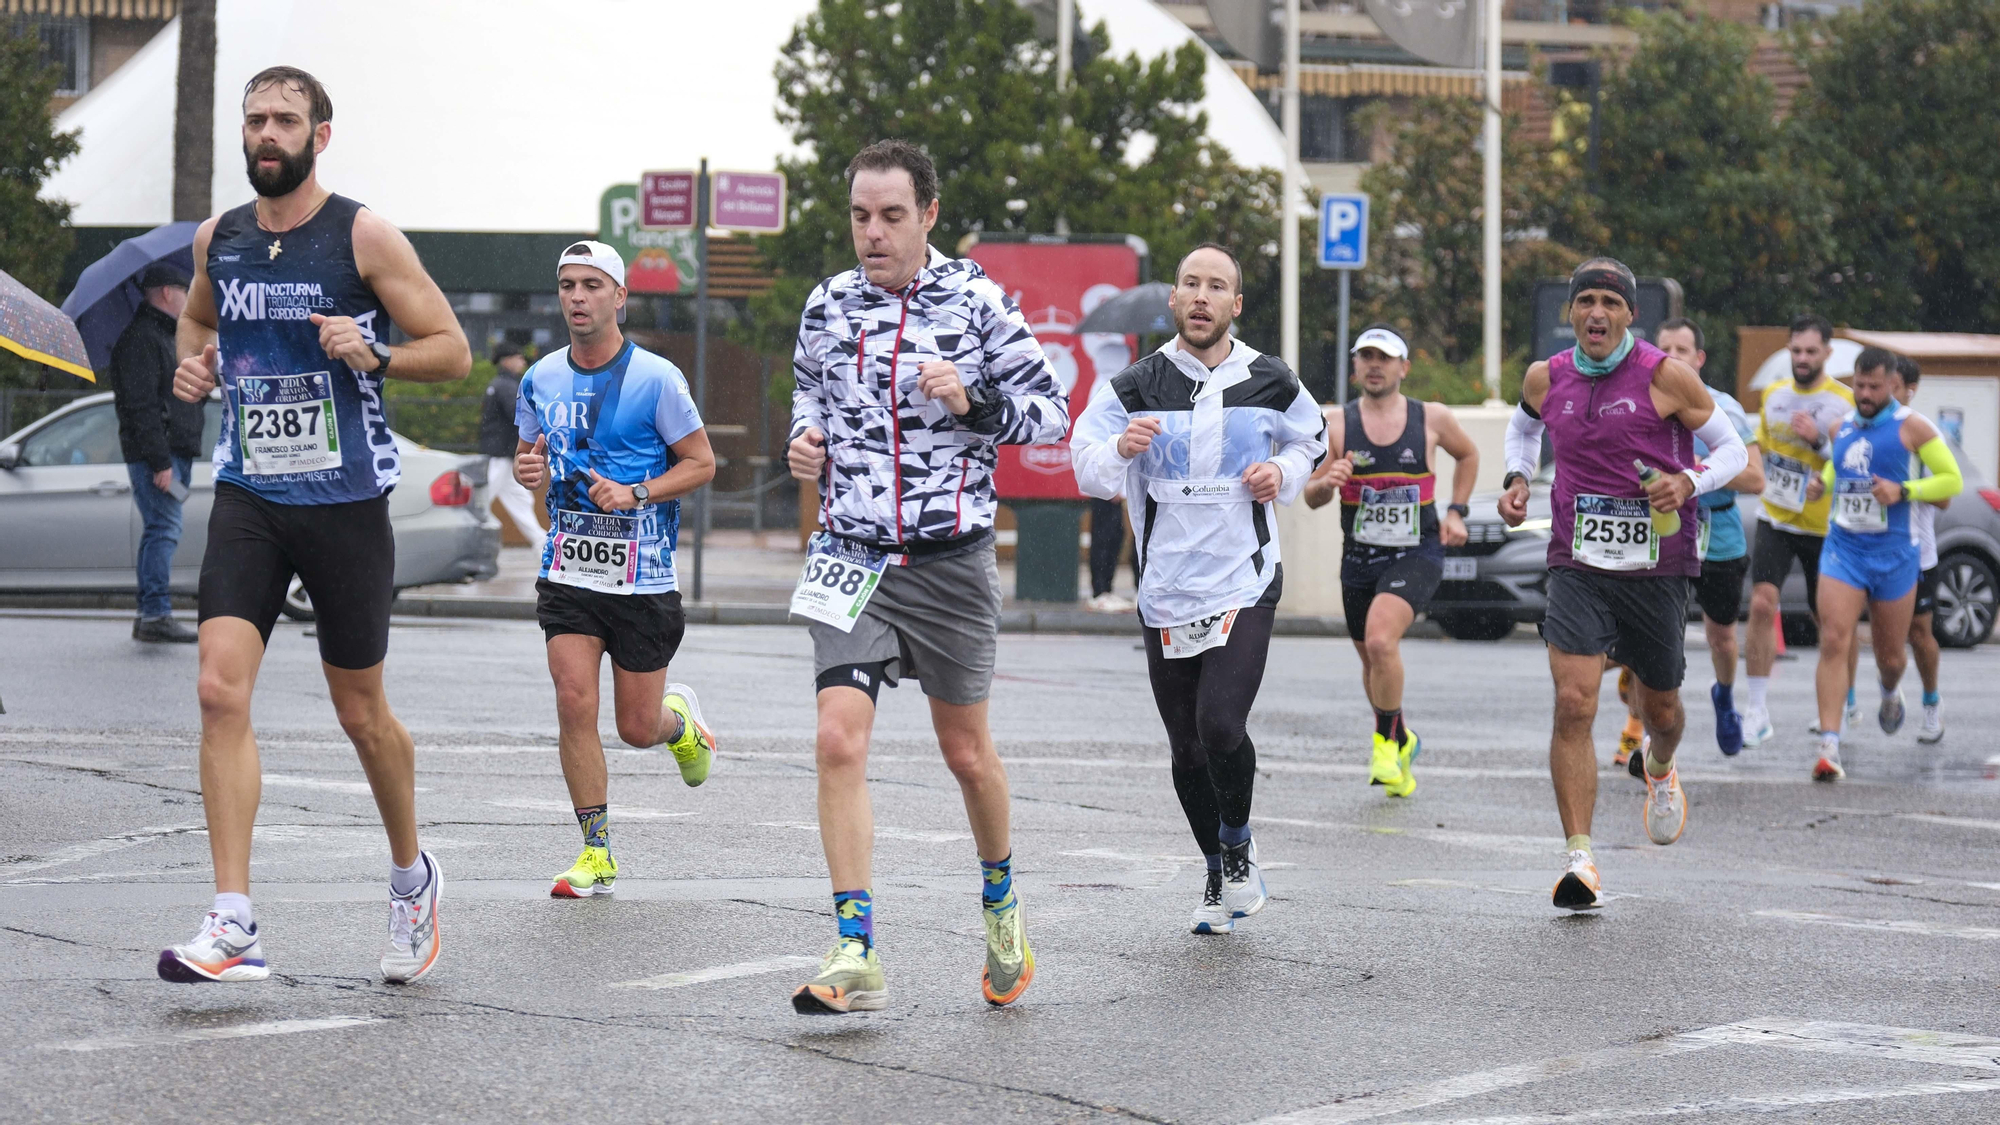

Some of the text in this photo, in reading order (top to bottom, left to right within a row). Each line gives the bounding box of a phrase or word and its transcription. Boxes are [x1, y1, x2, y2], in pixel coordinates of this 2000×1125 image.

[1328, 201, 1360, 241] P
[265, 283, 323, 297] NOCTURNA
[218, 278, 266, 321] XXII
[266, 296, 334, 309] TROTACALLES
[278, 377, 308, 388] MEDIA
[245, 388, 264, 403] 59
[352, 309, 401, 493] NOCTURA
[247, 405, 321, 439] 2387
[255, 443, 318, 455] FRANCISCO SOLANO
[297, 456, 326, 466] IMDECO
[250, 470, 341, 484] #SUDAACAMISETA
[1192, 485, 1230, 493] Columbia
[1843, 498, 1873, 514] 797
[592, 516, 621, 527] MEDIA
[1363, 506, 1411, 525] 2851
[1583, 518, 1648, 544] 2538
[562, 537, 627, 567] 5065
[578, 566, 609, 576] ALEJANDRO
[814, 606, 841, 620] IMDECO
[859, 670, 870, 687] NBA
